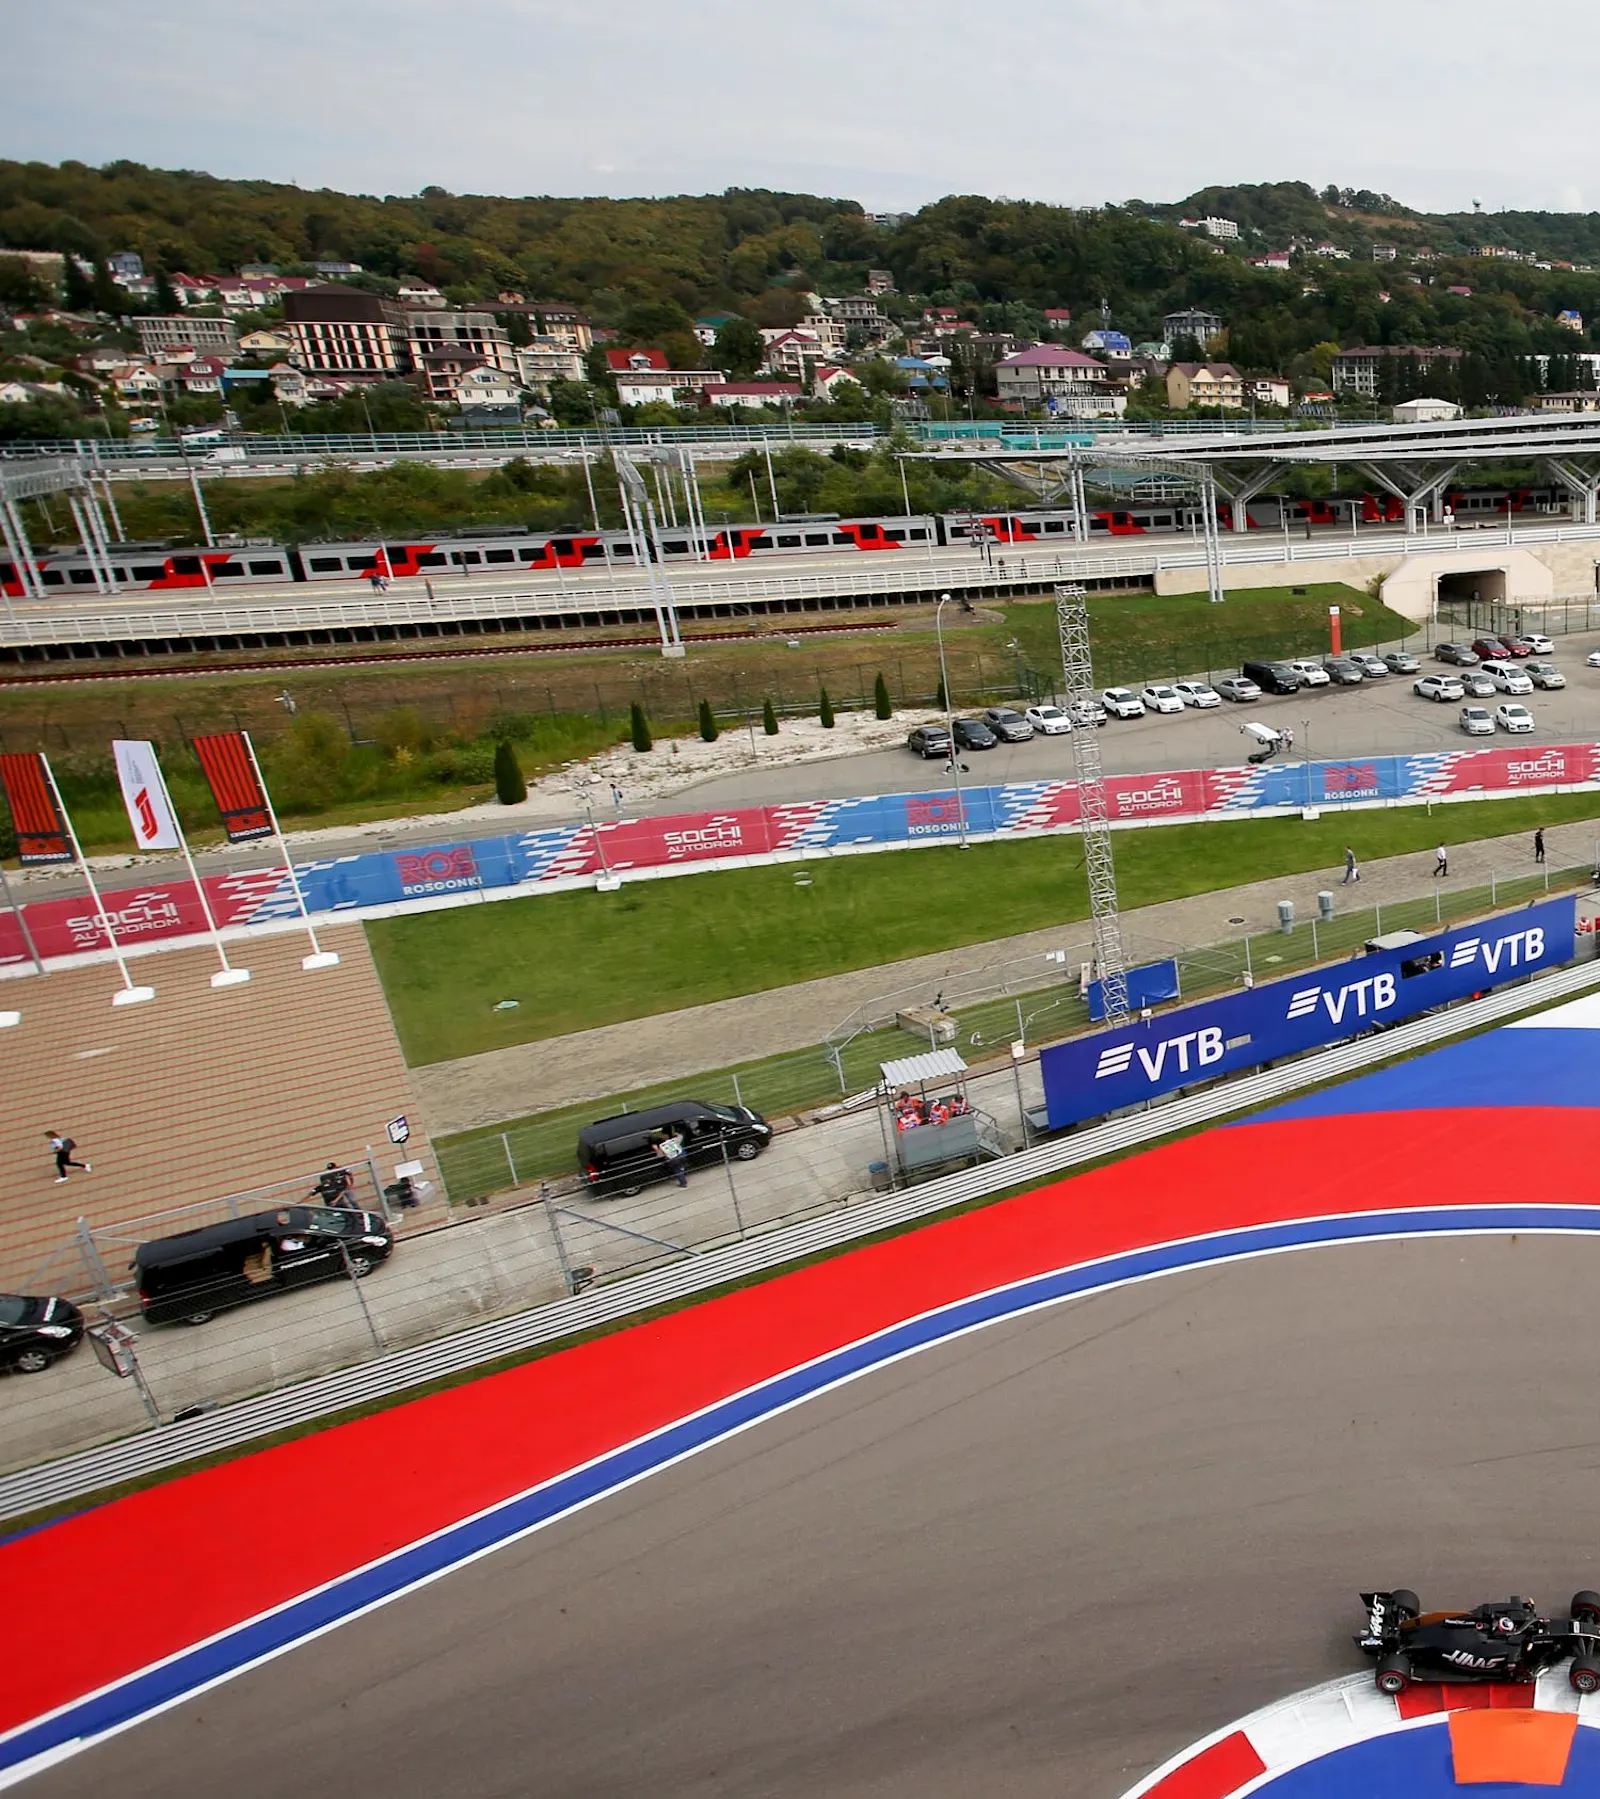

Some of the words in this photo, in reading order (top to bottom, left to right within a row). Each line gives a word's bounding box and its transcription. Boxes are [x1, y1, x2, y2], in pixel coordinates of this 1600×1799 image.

[1507, 759, 1564, 773] SOCHI
[1508, 771, 1564, 780] AUTODROM
[1116, 788, 1182, 804] SOCHI
[1324, 788, 1378, 800] ROSGONKI
[1119, 800, 1182, 811] AUTODROM
[663, 826, 740, 845] SOCHI
[667, 839, 743, 853] AUTODROM
[403, 876, 483, 895] ROSGONKI
[67, 903, 178, 933] SOCHI
[73, 917, 181, 942] AUTODROM
[1482, 928, 1544, 973] VTB
[1323, 974, 1395, 1023] VTB
[1138, 1027, 1223, 1081] VTB
[1442, 1649, 1505, 1669] HAAS
